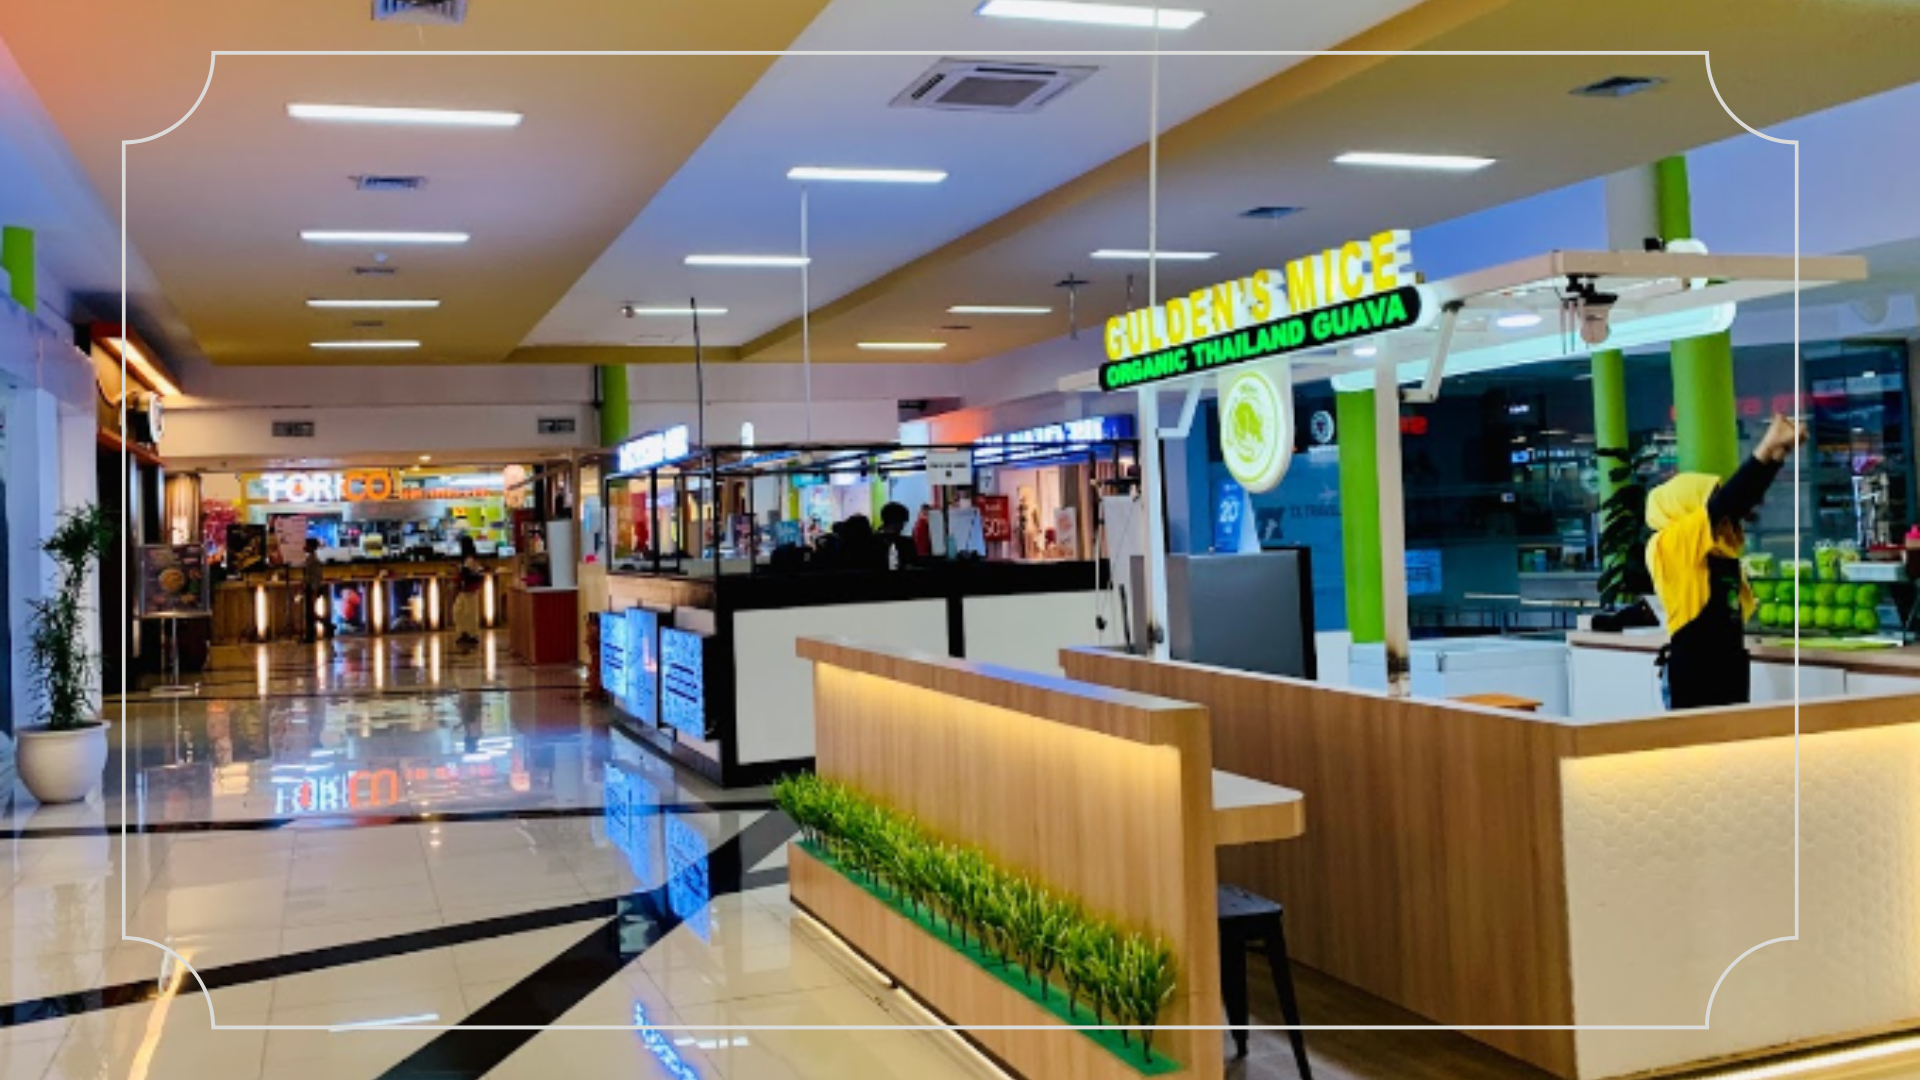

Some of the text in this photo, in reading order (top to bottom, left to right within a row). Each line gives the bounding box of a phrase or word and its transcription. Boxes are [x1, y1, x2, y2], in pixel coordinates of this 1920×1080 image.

[1104, 229, 1408, 361] GULDEN'S MICE
[1106, 293, 1407, 386] ORGANIC THAILAND GUAVA
[262, 470, 391, 502] TORICO
